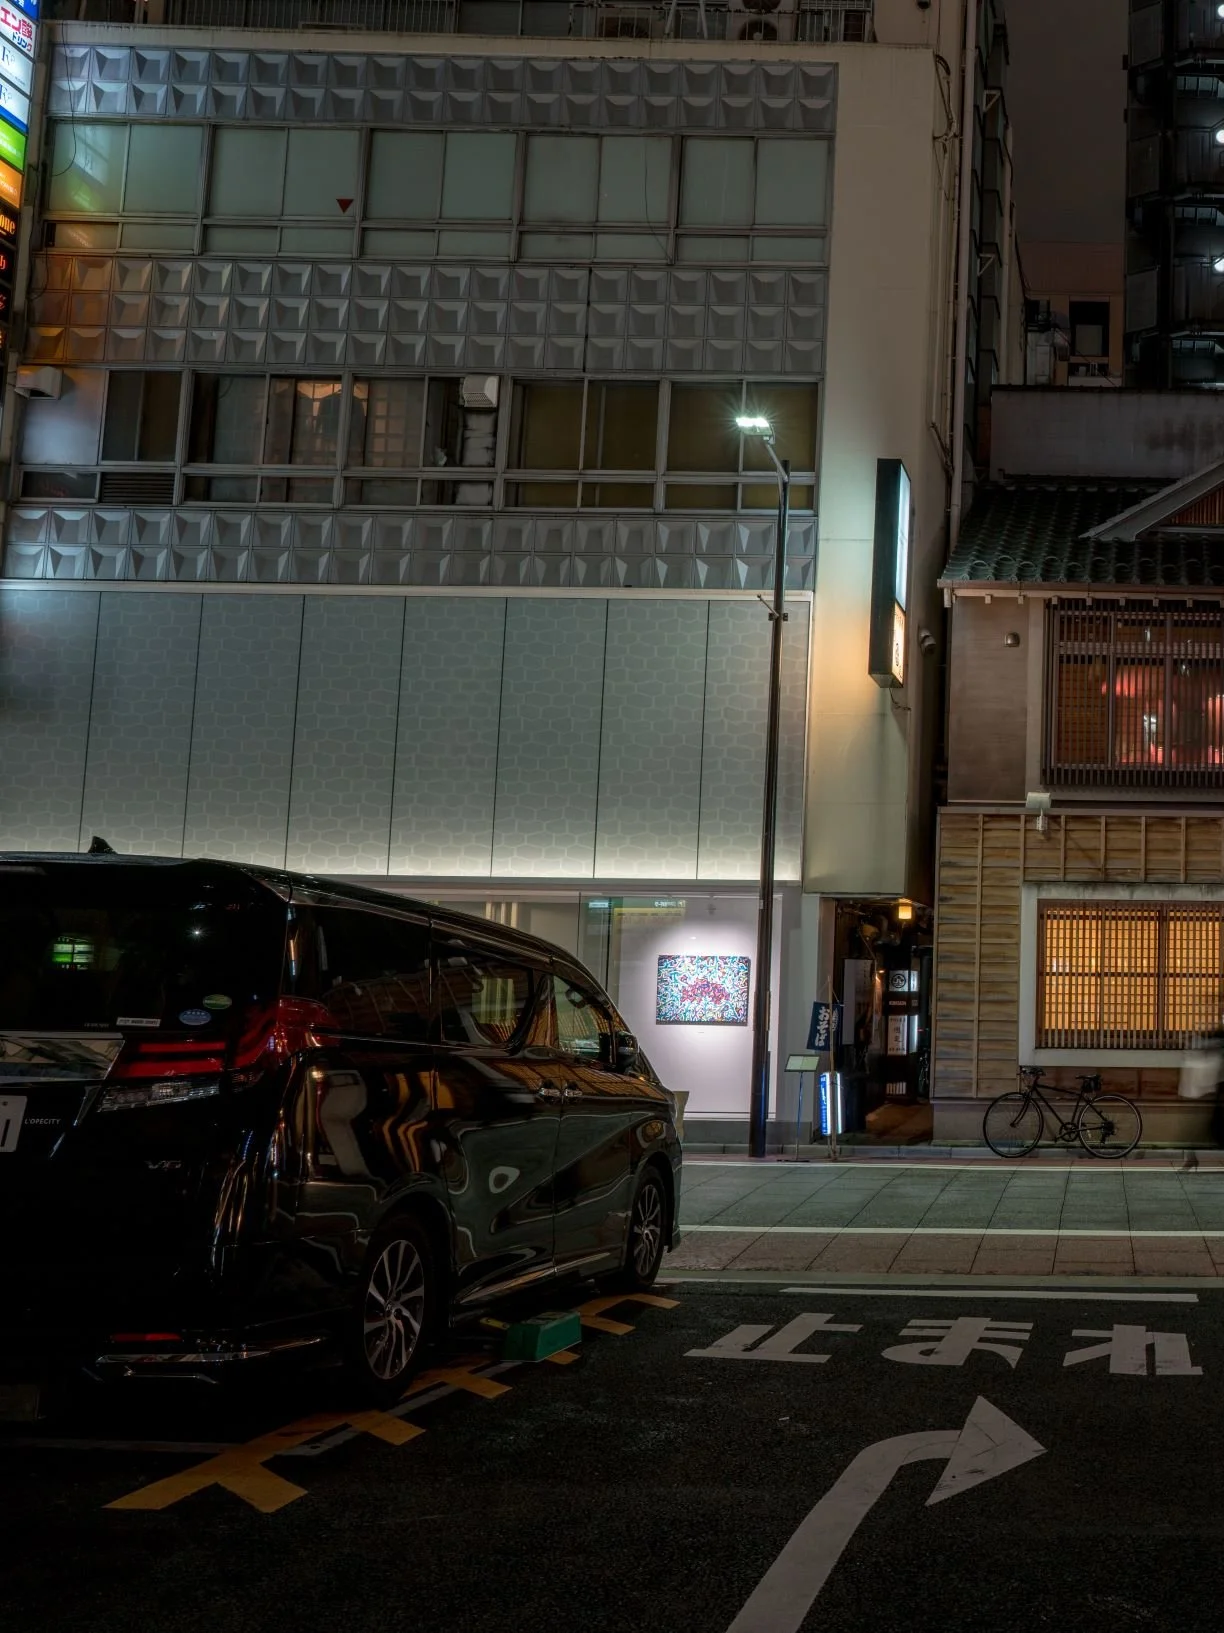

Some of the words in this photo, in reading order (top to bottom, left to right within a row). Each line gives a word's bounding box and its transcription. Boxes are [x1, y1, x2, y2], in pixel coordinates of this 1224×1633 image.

[815, 1006, 831, 1047] おそば
[683, 1312, 1205, 1376] 止まれ
